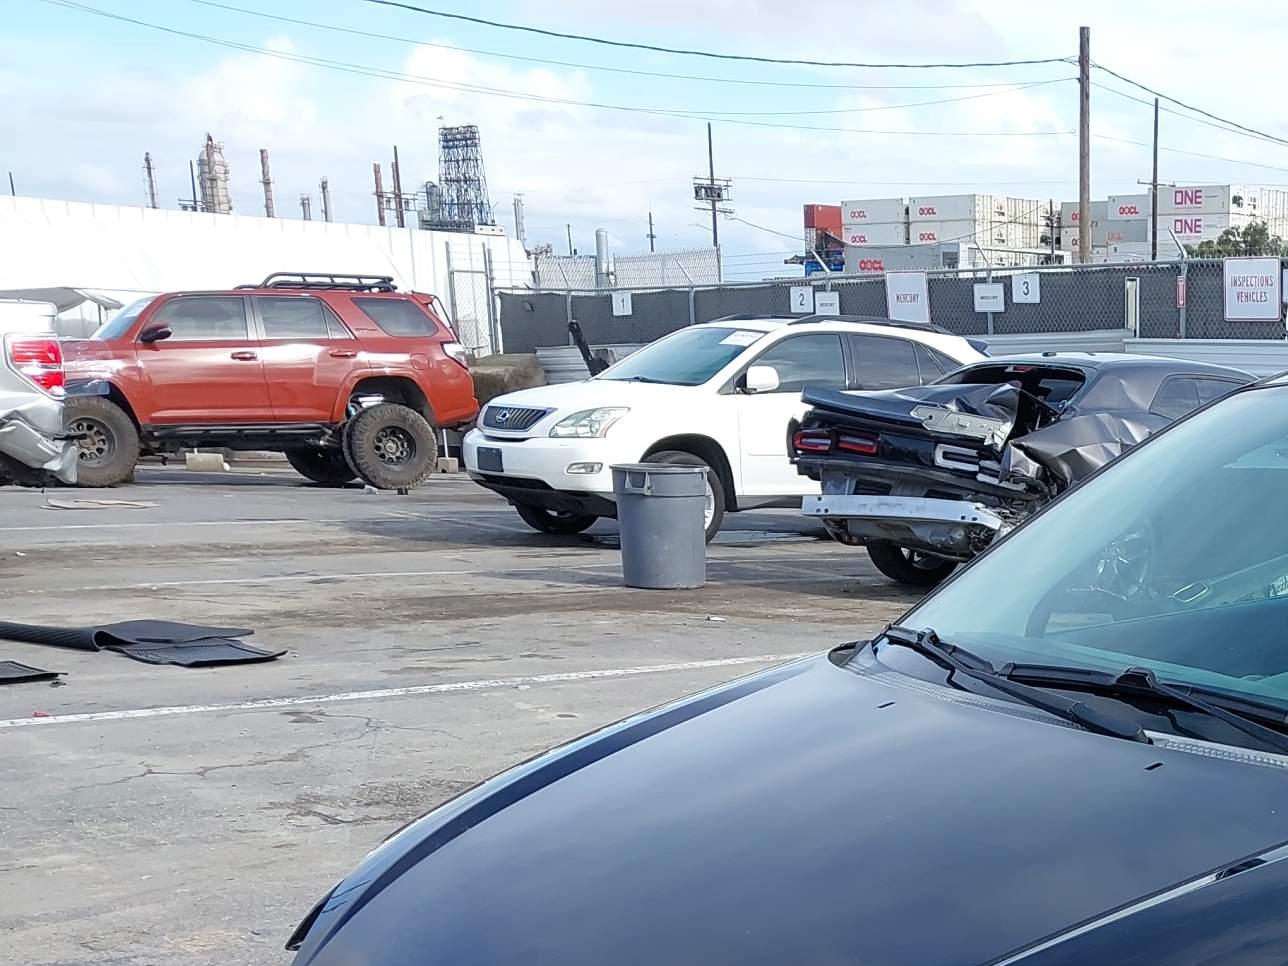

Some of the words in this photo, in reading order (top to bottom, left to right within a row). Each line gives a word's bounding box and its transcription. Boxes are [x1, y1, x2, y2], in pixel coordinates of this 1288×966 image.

[1174, 189, 1202, 205] ONE
[1173, 218, 1202, 234] ONE
[859, 259, 884, 272] OOCL
[1022, 280, 1030, 296] 3
[1230, 275, 1274, 288] INSPECTIONS
[798, 293, 805, 306] 2
[1236, 291, 1268, 303] VEHICLES
